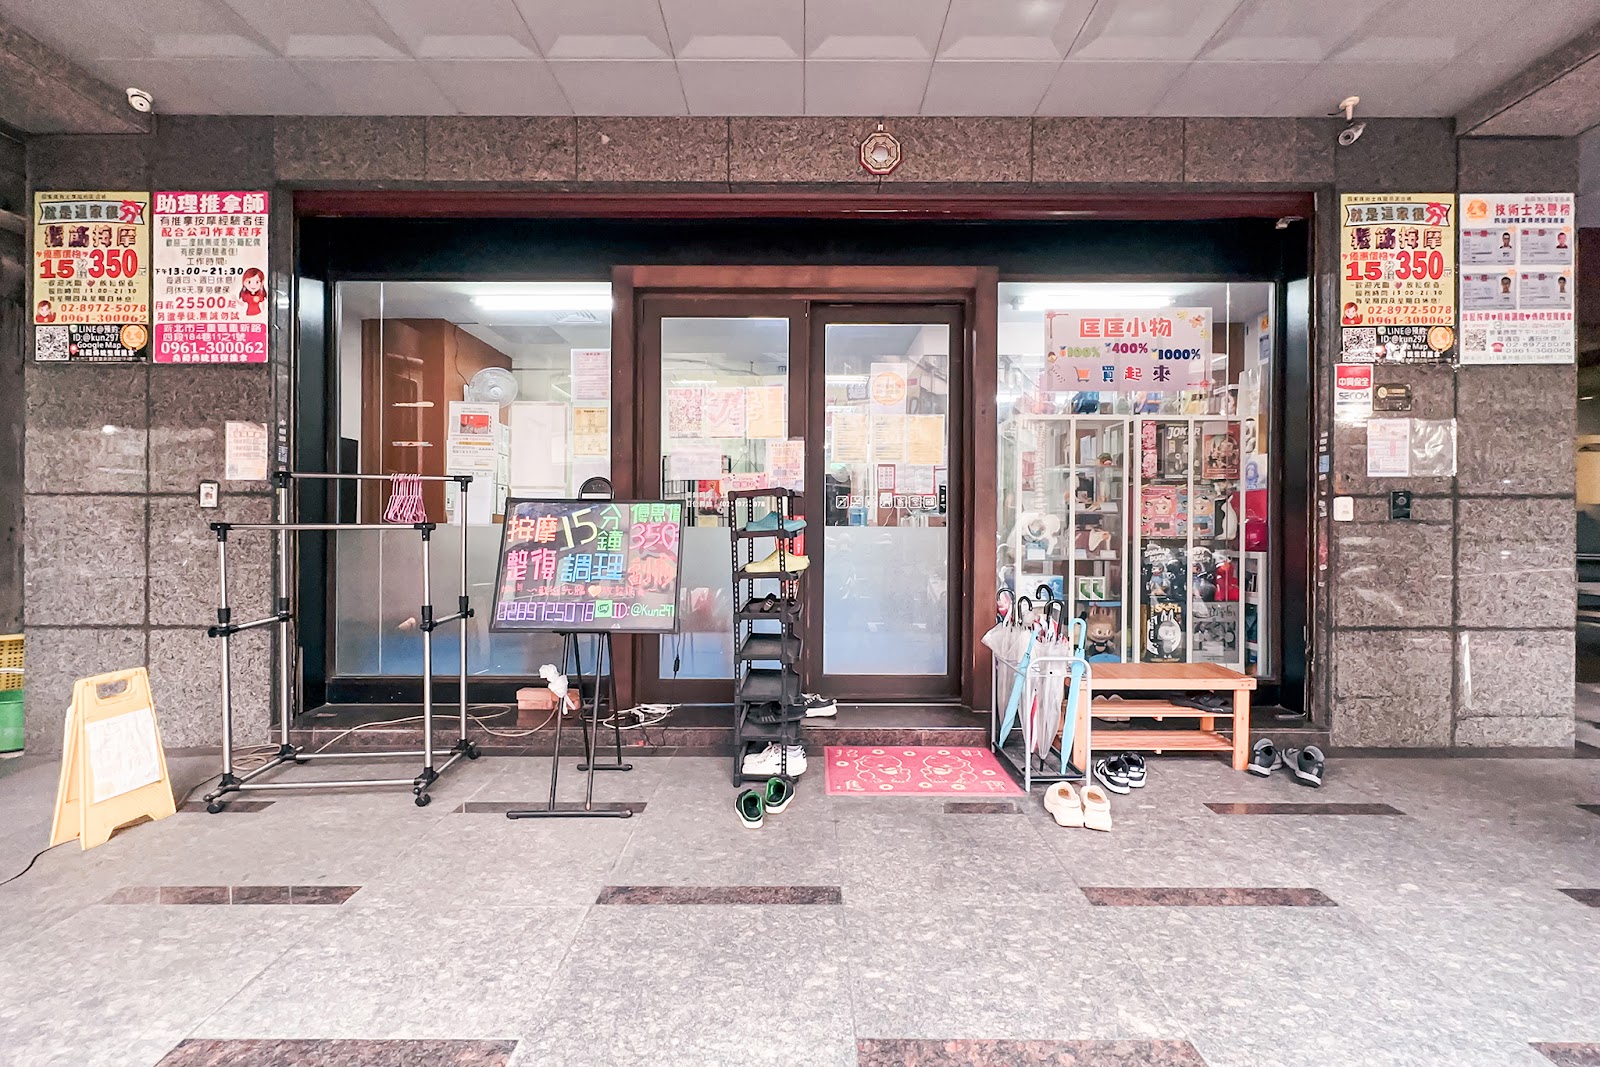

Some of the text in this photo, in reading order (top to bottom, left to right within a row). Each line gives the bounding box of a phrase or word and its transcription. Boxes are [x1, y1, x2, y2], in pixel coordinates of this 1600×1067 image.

[156, 194, 264, 213] 助理推拿師
[161, 227, 262, 237] 配合公司作業程序
[40, 259, 75, 279] 15
[88, 249, 138, 279] 350
[1346, 261, 1382, 281] 15
[1395, 250, 1444, 280] 350
[61, 304, 147, 312] 02-8972-5078
[1367, 305, 1452, 314] 02-8972-5078
[61, 314, 147, 323] 0961-300062
[1367, 316, 1452, 325] 0961-300062
[1080, 317, 1172, 338] 匡匡小物
[77, 342, 122, 351] Google Map
[161, 341, 264, 354] 0961-300062
[1111, 342, 1148, 354] 400%
[1158, 348, 1201, 360] 1000%
[1338, 392, 1369, 400] SECOM
[1167, 427, 1201, 440] JOKR
[507, 514, 558, 544] 按摩
[629, 523, 677, 550] 350
